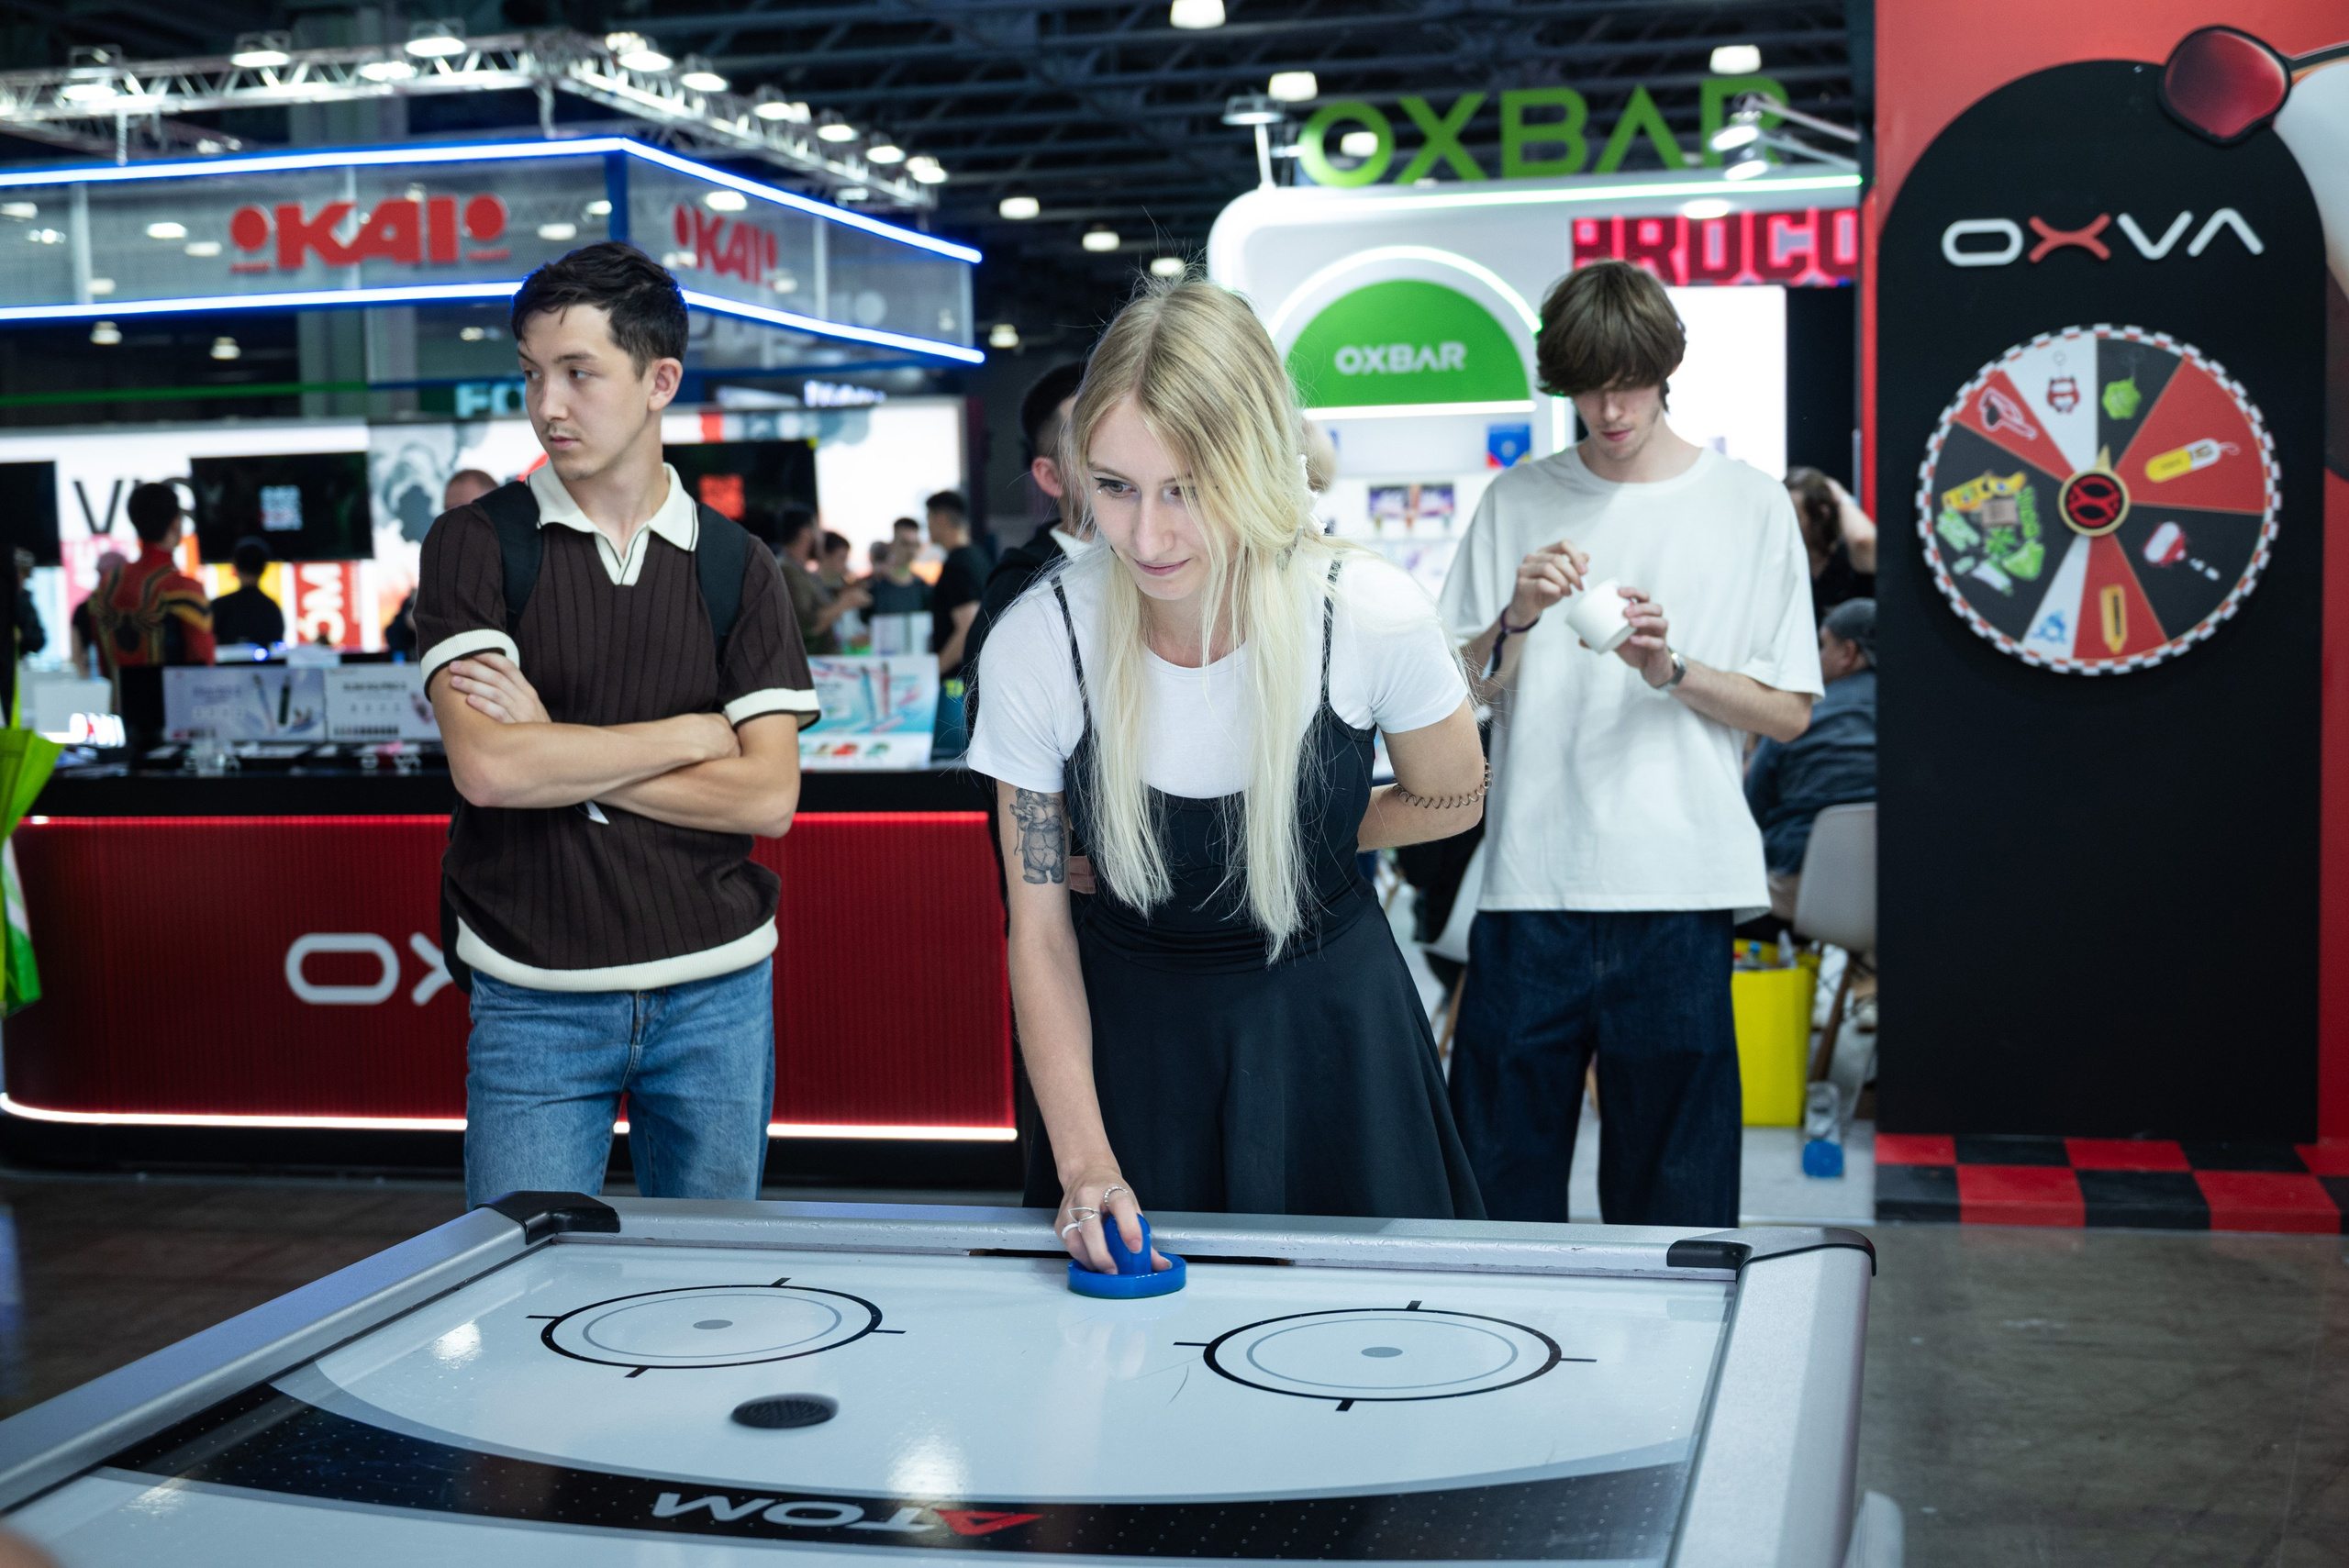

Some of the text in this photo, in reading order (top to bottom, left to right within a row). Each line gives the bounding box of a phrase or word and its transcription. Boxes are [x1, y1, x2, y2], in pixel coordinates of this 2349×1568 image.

[1298, 76, 1790, 186] OXBAR
[1942, 207, 2265, 267] OXVA
[1334, 340, 1467, 375] OXBAR
[651, 1493, 1044, 1537] ATOM
